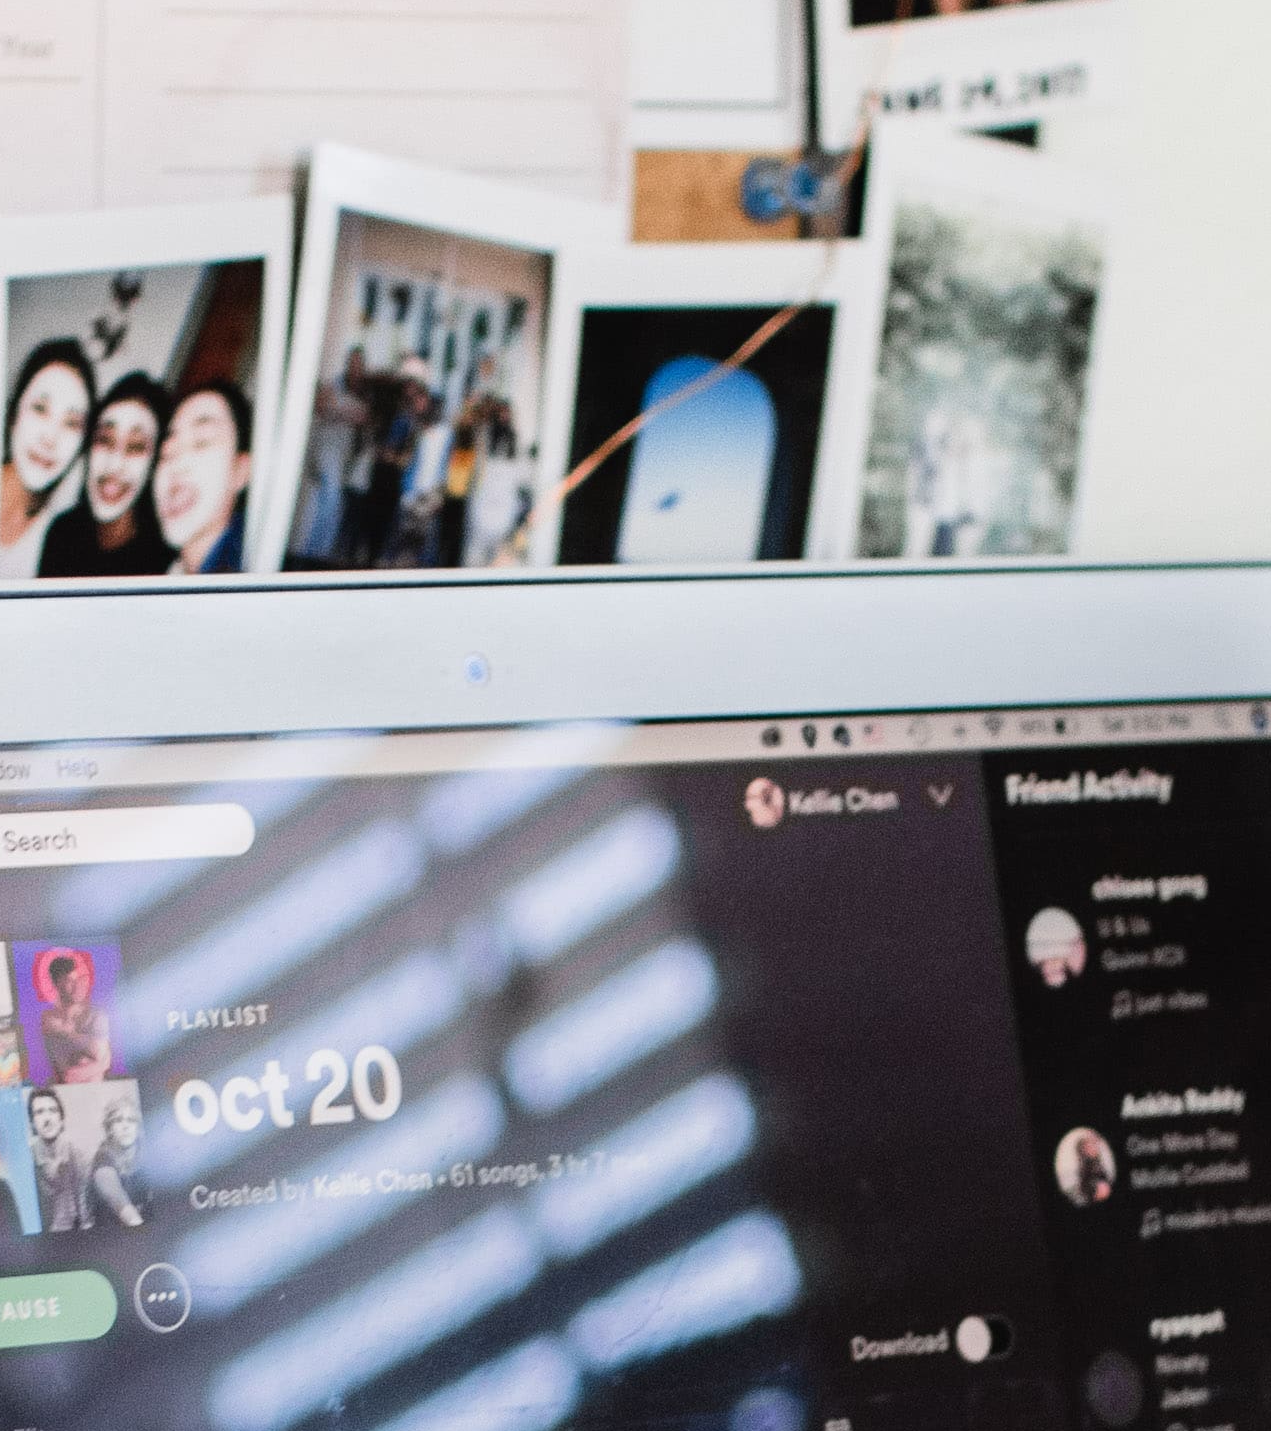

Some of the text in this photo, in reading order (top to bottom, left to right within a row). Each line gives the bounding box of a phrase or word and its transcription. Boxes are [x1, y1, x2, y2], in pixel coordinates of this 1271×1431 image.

[56, 758, 99, 779] Help
[844, 784, 900, 814] Chen
[1004, 767, 1175, 806] Friend Activity
[2, 829, 78, 852] Search
[165, 1003, 270, 1032] PLAYLIST
[173, 1044, 403, 1136] oct 20
[189, 1181, 277, 1212] Created
[375, 1168, 434, 1195] Chen
[449, 1162, 477, 1188] 61
[478, 1159, 545, 1188] songs,
[850, 1328, 951, 1363] Download
